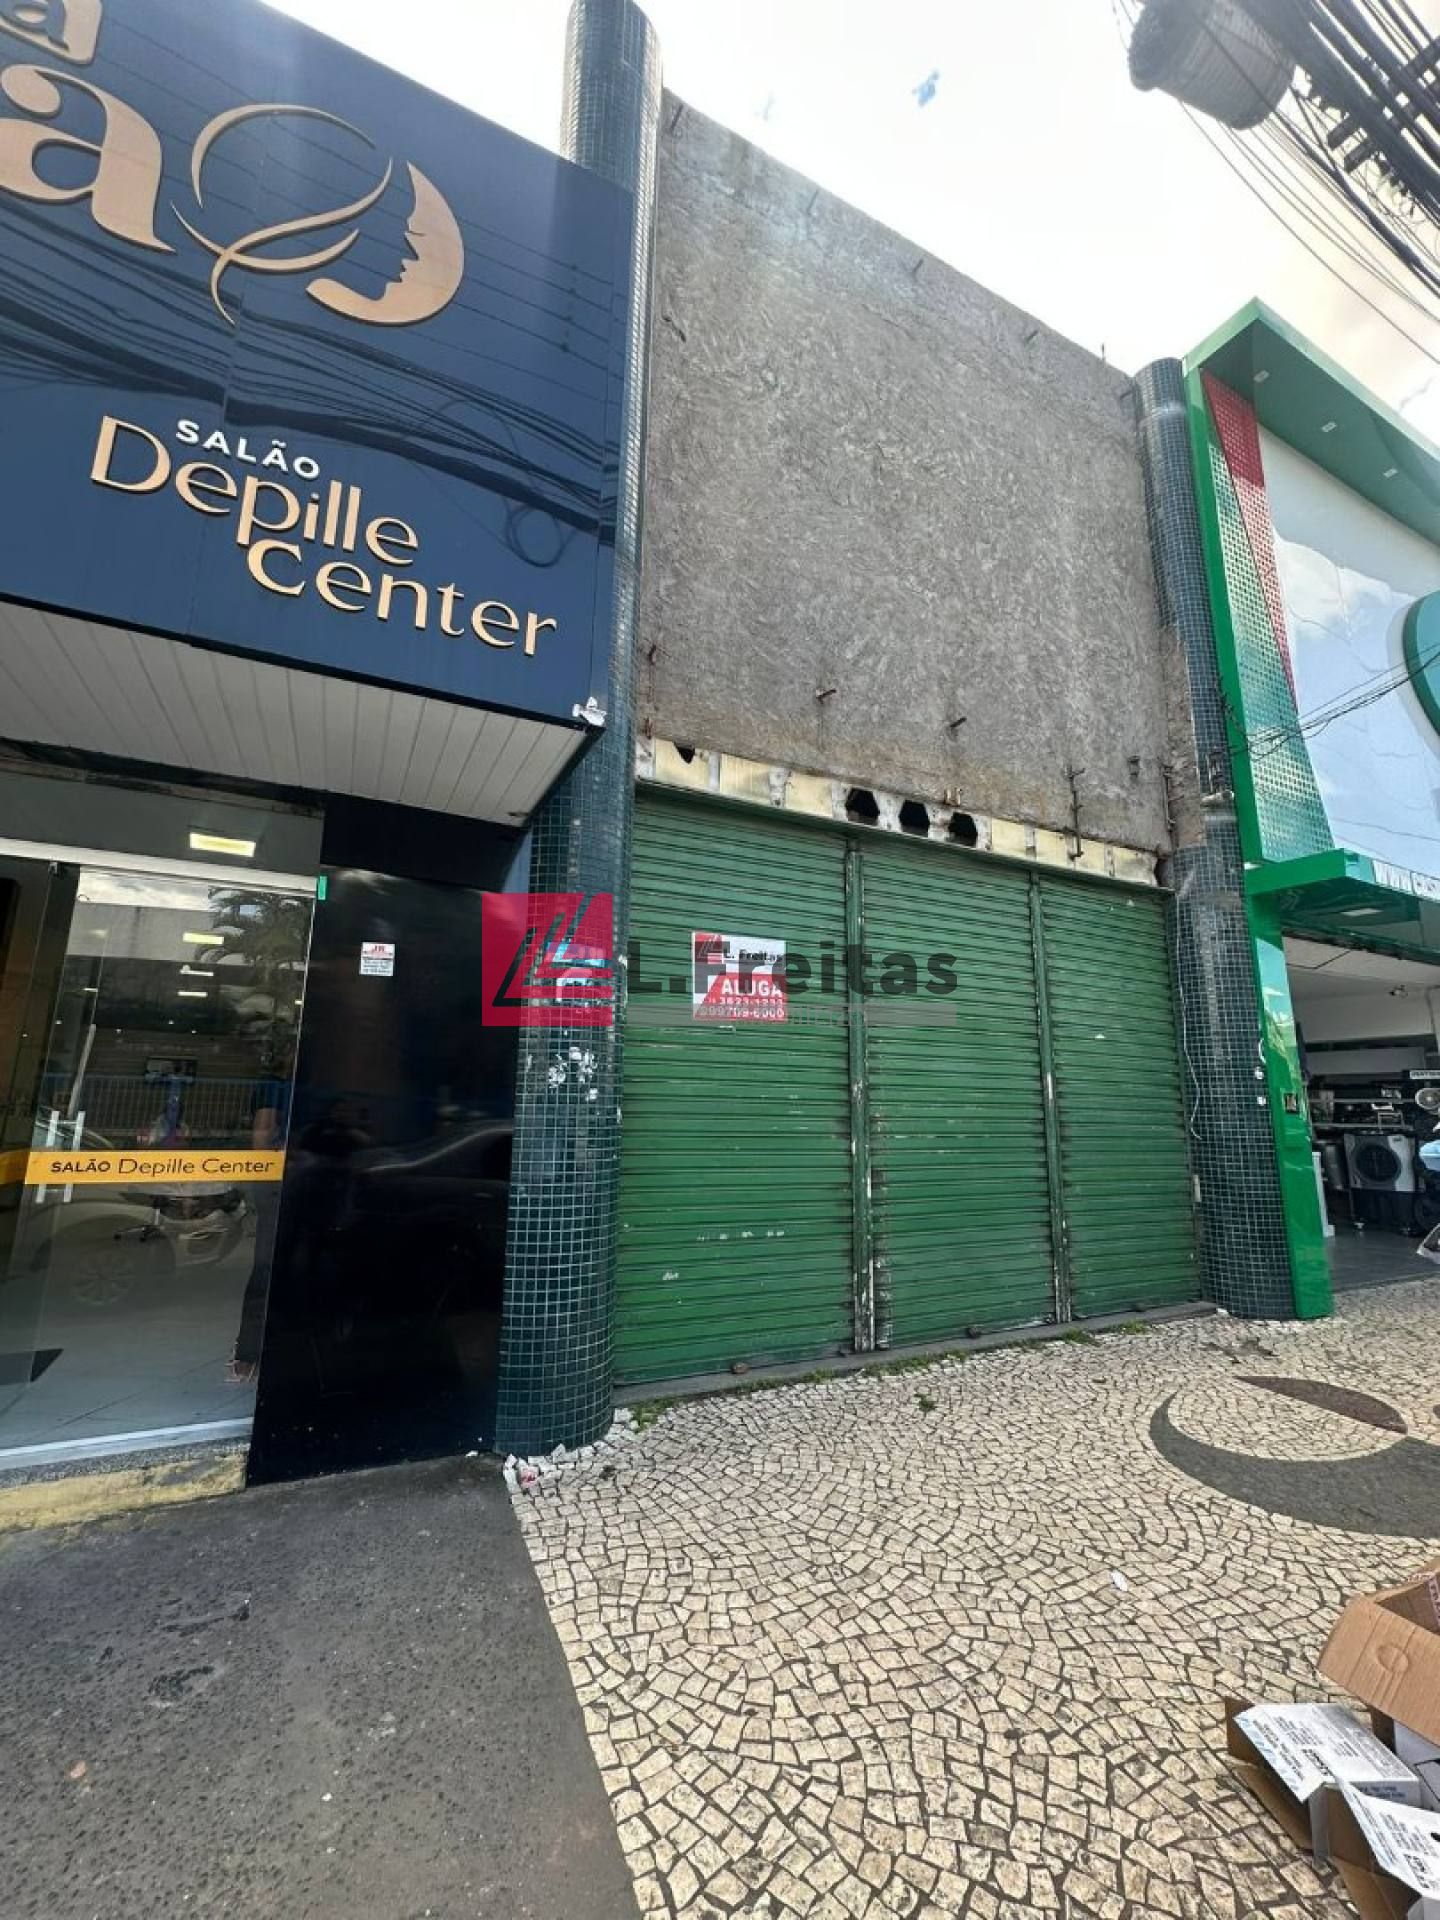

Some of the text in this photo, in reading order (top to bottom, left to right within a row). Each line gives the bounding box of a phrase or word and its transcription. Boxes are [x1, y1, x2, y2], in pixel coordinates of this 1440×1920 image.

[176, 419, 320, 480] SALÃO
[90, 414, 419, 565] Depille
[247, 538, 557, 655] Center
[721, 979, 783, 998] ALUGA
[51, 1158, 274, 1177] SALÃO Depille Center
